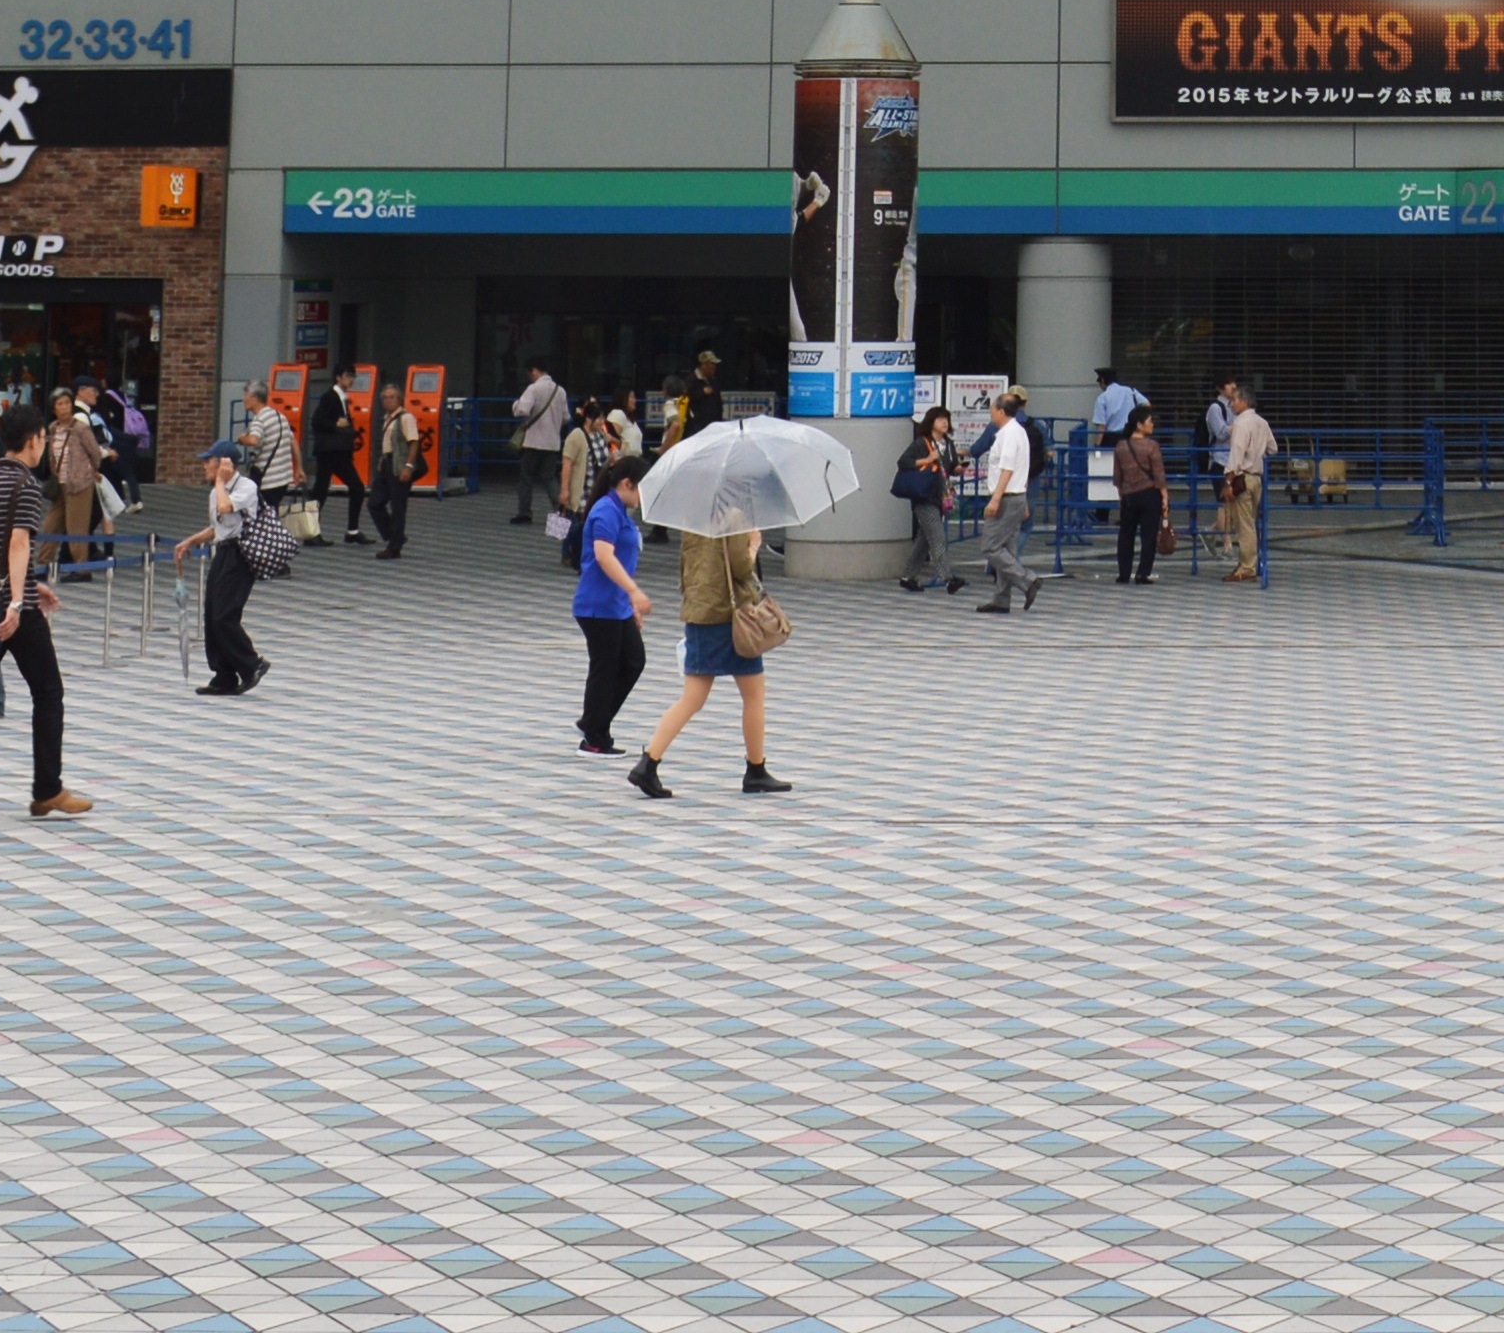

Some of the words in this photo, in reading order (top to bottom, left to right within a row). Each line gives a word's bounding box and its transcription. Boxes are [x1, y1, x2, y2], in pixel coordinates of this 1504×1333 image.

[1177, 10, 1413, 72] GIANTS
[377, 189, 416, 204] ゲート
[1399, 183, 1450, 202] ゲート
[333, 187, 374, 219] 23
[376, 205, 416, 218] GATE
[873, 209, 883, 226] 9
[1398, 205, 1451, 222] GATE
[795, 352, 820, 364] 2015
[859, 388, 898, 410] 7/17
